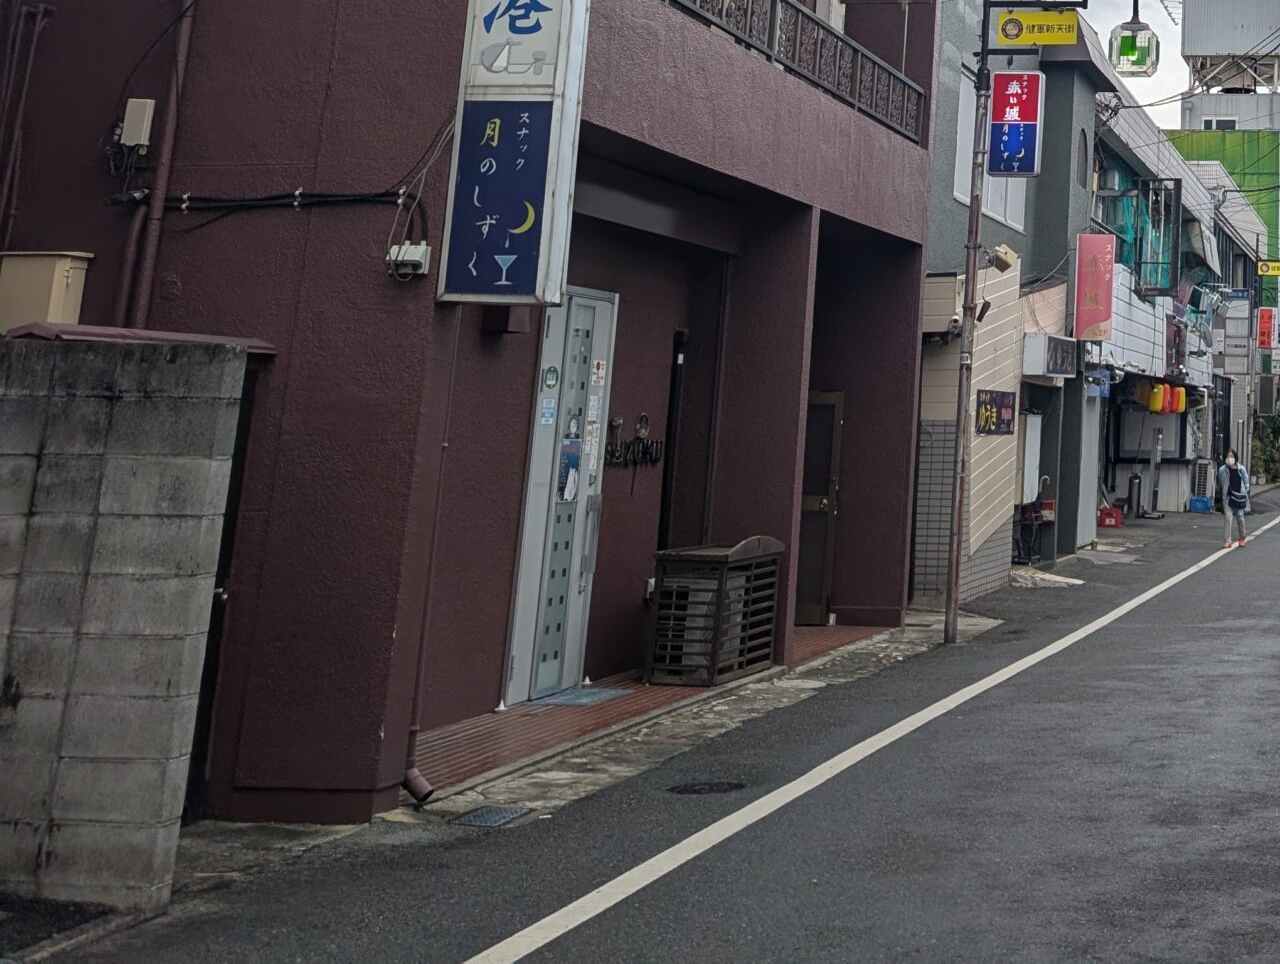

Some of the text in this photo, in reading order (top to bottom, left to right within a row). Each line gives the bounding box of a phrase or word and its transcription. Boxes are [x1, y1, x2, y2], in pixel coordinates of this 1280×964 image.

[1026, 23, 1075, 34] 健軍新天街
[1004, 79, 1022, 121] 赤い城
[515, 111, 531, 172] スナック
[468, 118, 501, 278] 月のしずく
[1104, 244, 1112, 282] スナック
[979, 403, 998, 431] ゆうき
